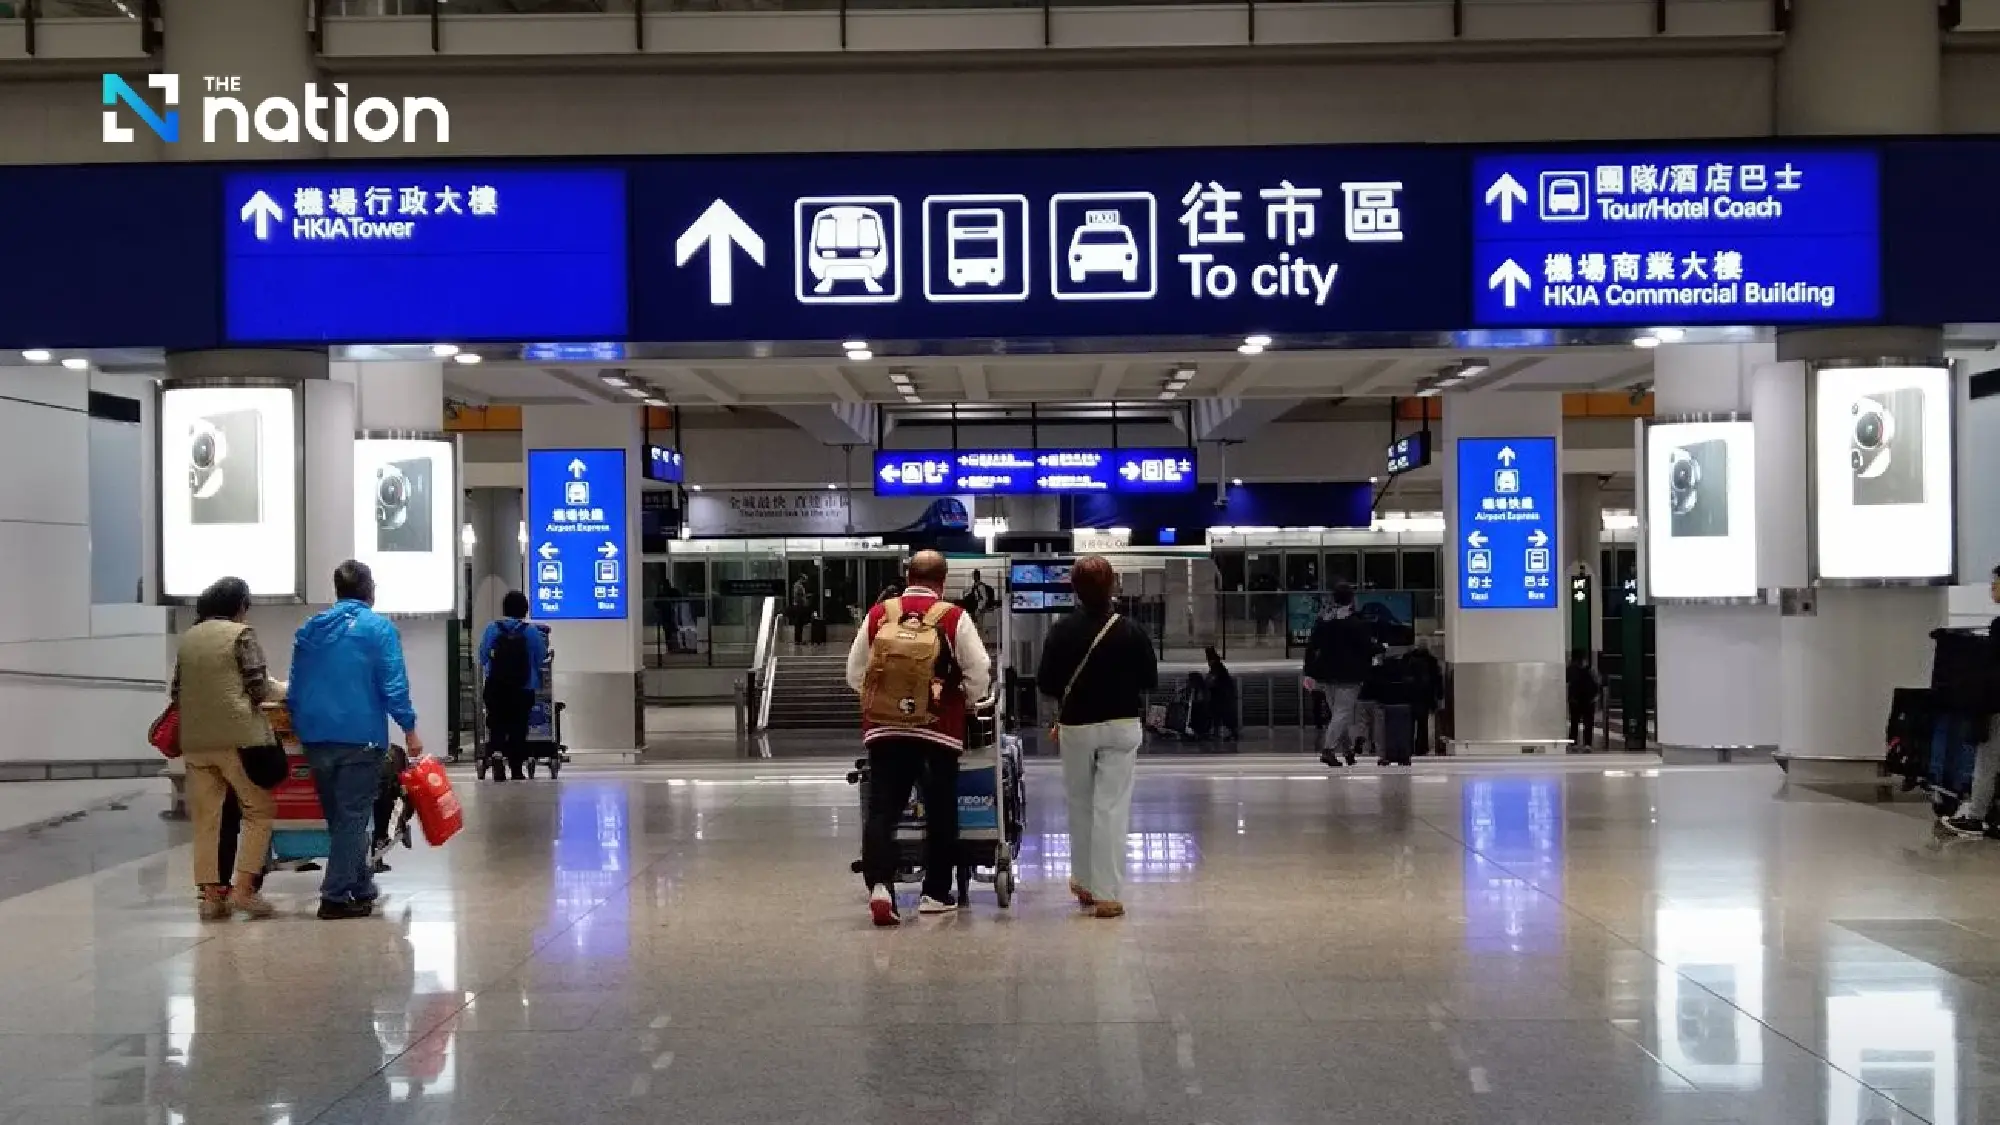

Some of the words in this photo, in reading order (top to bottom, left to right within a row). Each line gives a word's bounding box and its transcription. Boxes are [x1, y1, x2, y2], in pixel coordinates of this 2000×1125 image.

[1596, 162, 1804, 194] 團隊/酒店巴士
[293, 185, 498, 216] 機場行政大樓
[1177, 179, 1404, 247] 往市區
[1596, 196, 1710, 220] Tour/Hotel
[1713, 195, 1783, 219] Coach
[293, 217, 348, 240] HKIA
[349, 217, 415, 240] Tower
[1177, 252, 1238, 300] To
[1251, 252, 1339, 306] city
[1544, 251, 1745, 283] 機場商業大樓
[1543, 284, 1601, 307] HKIA
[1605, 283, 1738, 306] Commercial
[1744, 283, 1836, 308] Building
[594, 586, 619, 598] 巴士
[1524, 575, 1550, 588] 巴士
